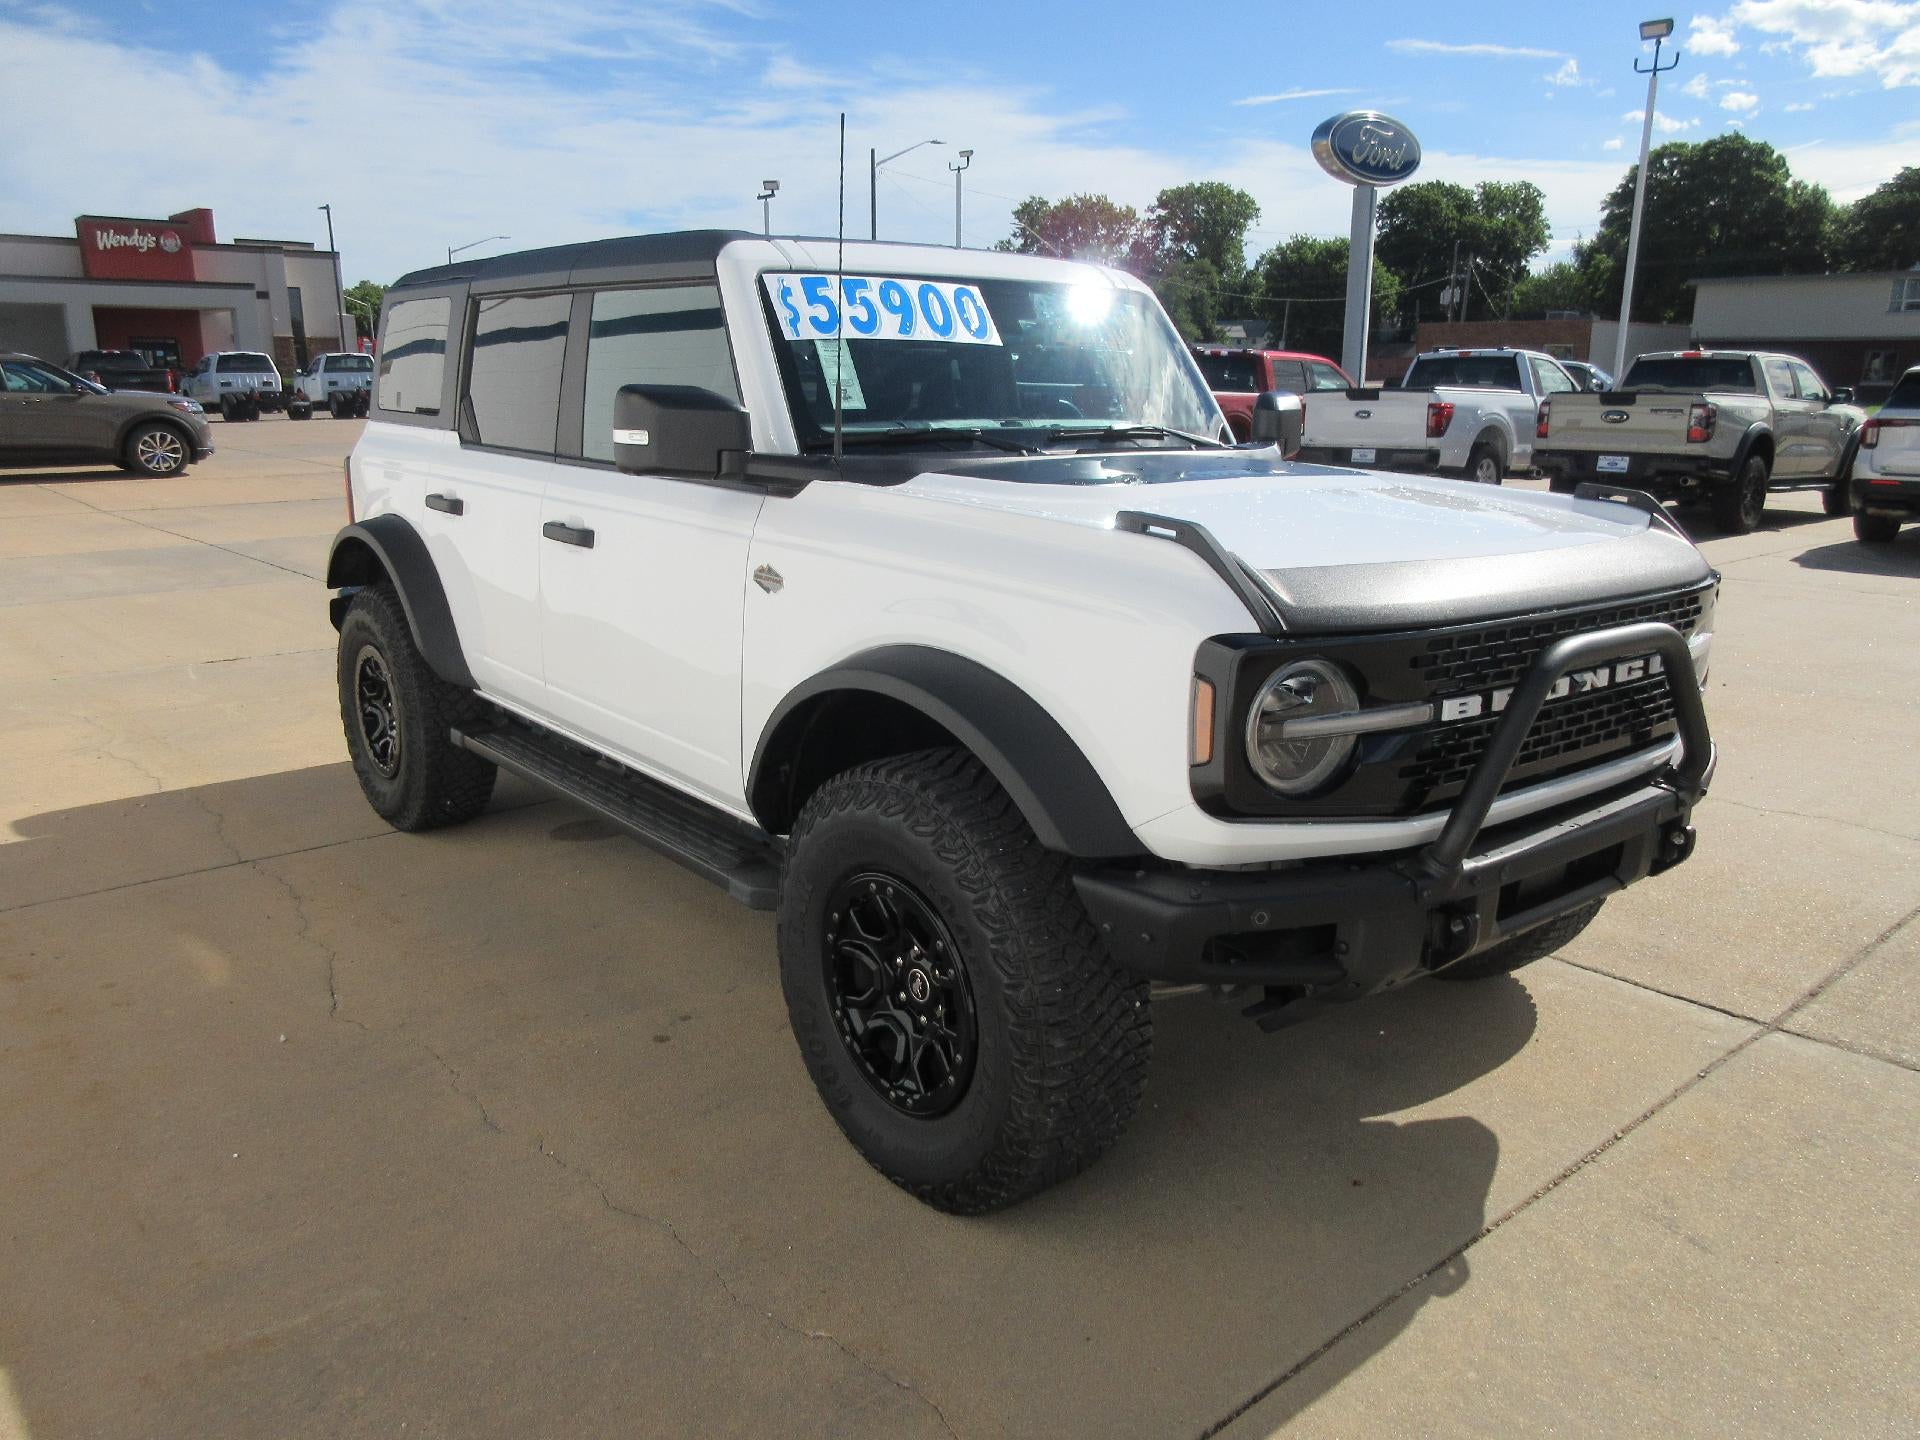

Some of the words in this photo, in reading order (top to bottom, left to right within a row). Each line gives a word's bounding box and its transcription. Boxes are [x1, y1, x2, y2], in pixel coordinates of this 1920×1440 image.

[1352, 125, 1406, 170] Ford
[96, 228, 156, 252] Wendy's
[777, 276, 992, 341] $55900
